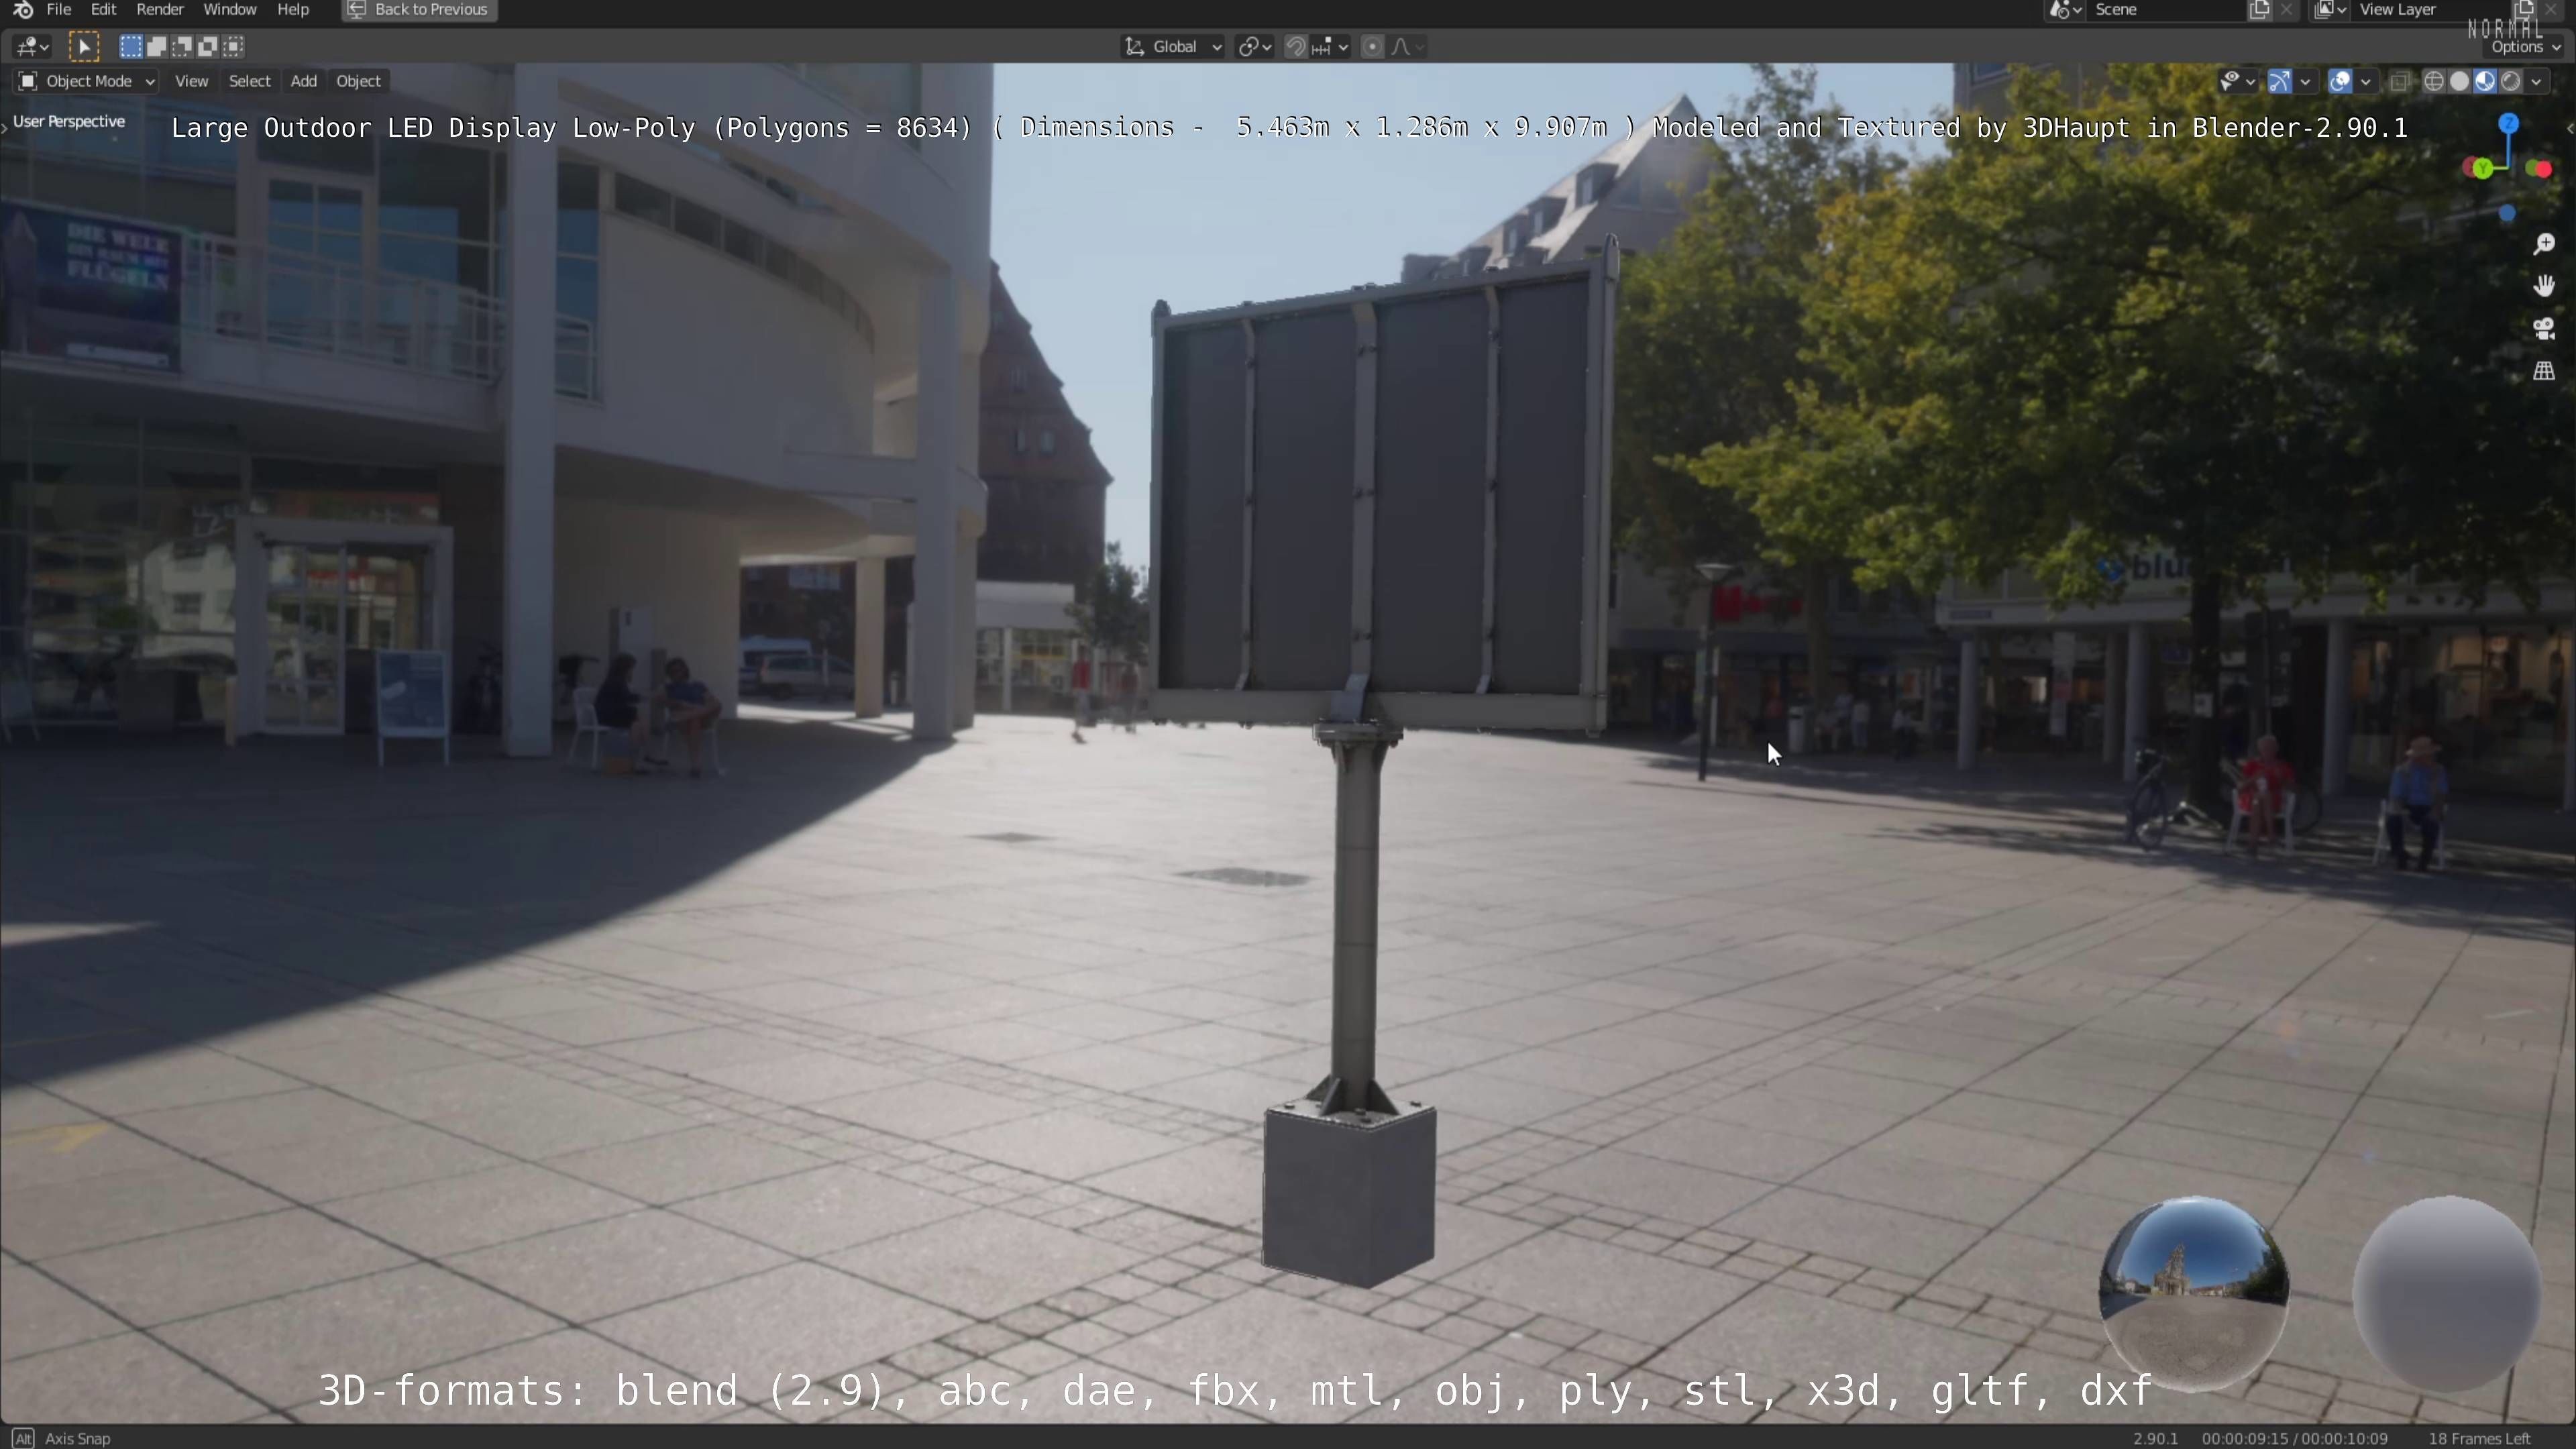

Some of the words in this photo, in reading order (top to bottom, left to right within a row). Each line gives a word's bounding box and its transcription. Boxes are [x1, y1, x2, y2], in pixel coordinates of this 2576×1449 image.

[47, 3, 72, 15] File
[91, 3, 117, 15] Edit
[137, 3, 184, 15] Render
[204, 3, 257, 15] Window
[278, 3, 309, 19] Help
[376, 2, 410, 15] Back
[413, 3, 427, 15] to
[431, 2, 488, 15] Previous
[2096, 3, 2137, 15] Scene
[2360, 3, 2394, 15] View
[2398, 3, 2436, 18] Layer
[1154, 40, 1196, 53] Global
[2492, 40, 2544, 56] Options
[47, 74, 91, 90] Object
[95, 74, 132, 87] Mode
[175, 74, 209, 87] View
[229, 74, 271, 87] Select
[290, 74, 317, 87] Add
[337, 74, 382, 90] Object
[13, 115, 46, 127] User
[49, 114, 125, 131] Perspective
[2133, 553, 2188, 580] blu
[15, 1432, 32, 1445] Alt
[45, 1432, 74, 1445] Axis
[78, 1432, 111, 1448] Snap
[2134, 1432, 2178, 1445] 2.90.1
[2202, 1432, 2288, 1445] 00:00:09:15
[2302, 1432, 2388, 1445] 00:00:10:09
[2430, 1432, 2447, 1445] 18
[2452, 1432, 2502, 1445] Frames
[2506, 1432, 2531, 1445] Left
